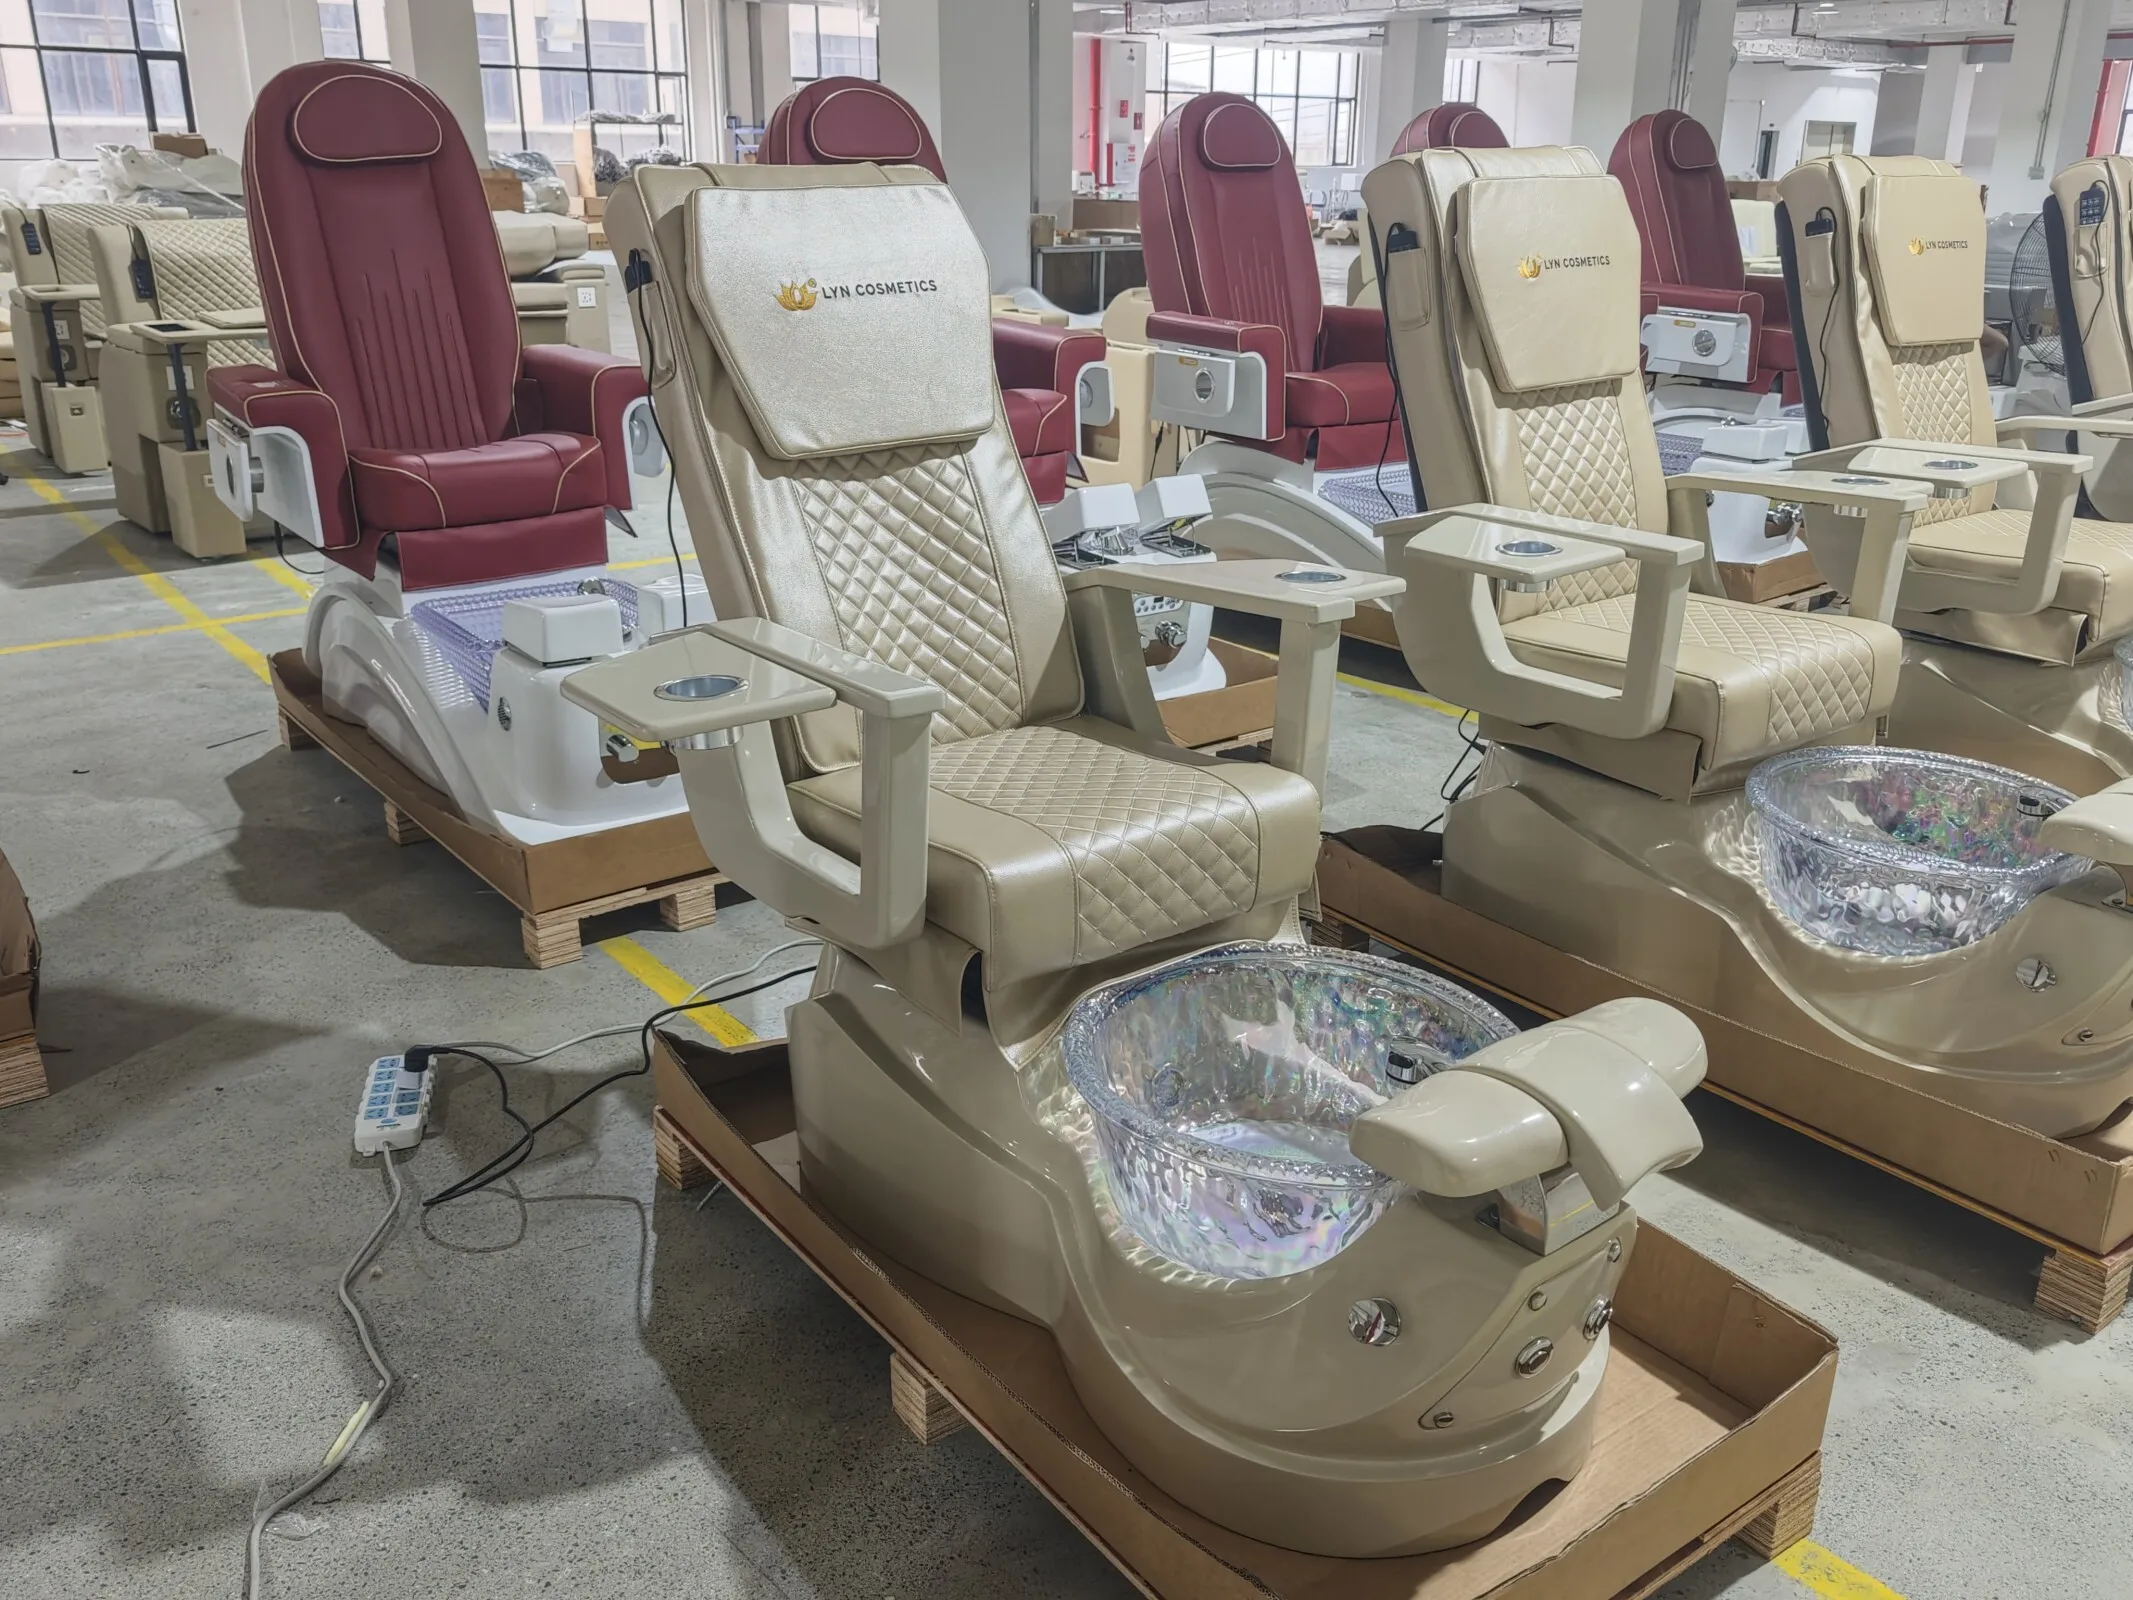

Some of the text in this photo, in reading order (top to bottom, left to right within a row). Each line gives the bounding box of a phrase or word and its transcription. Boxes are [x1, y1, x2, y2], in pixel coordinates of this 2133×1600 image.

[1926, 240, 1936, 249] LYN
[1543, 255, 1611, 270] LYN COSMETICS
[821, 279, 938, 299] LYN COSMETICS
